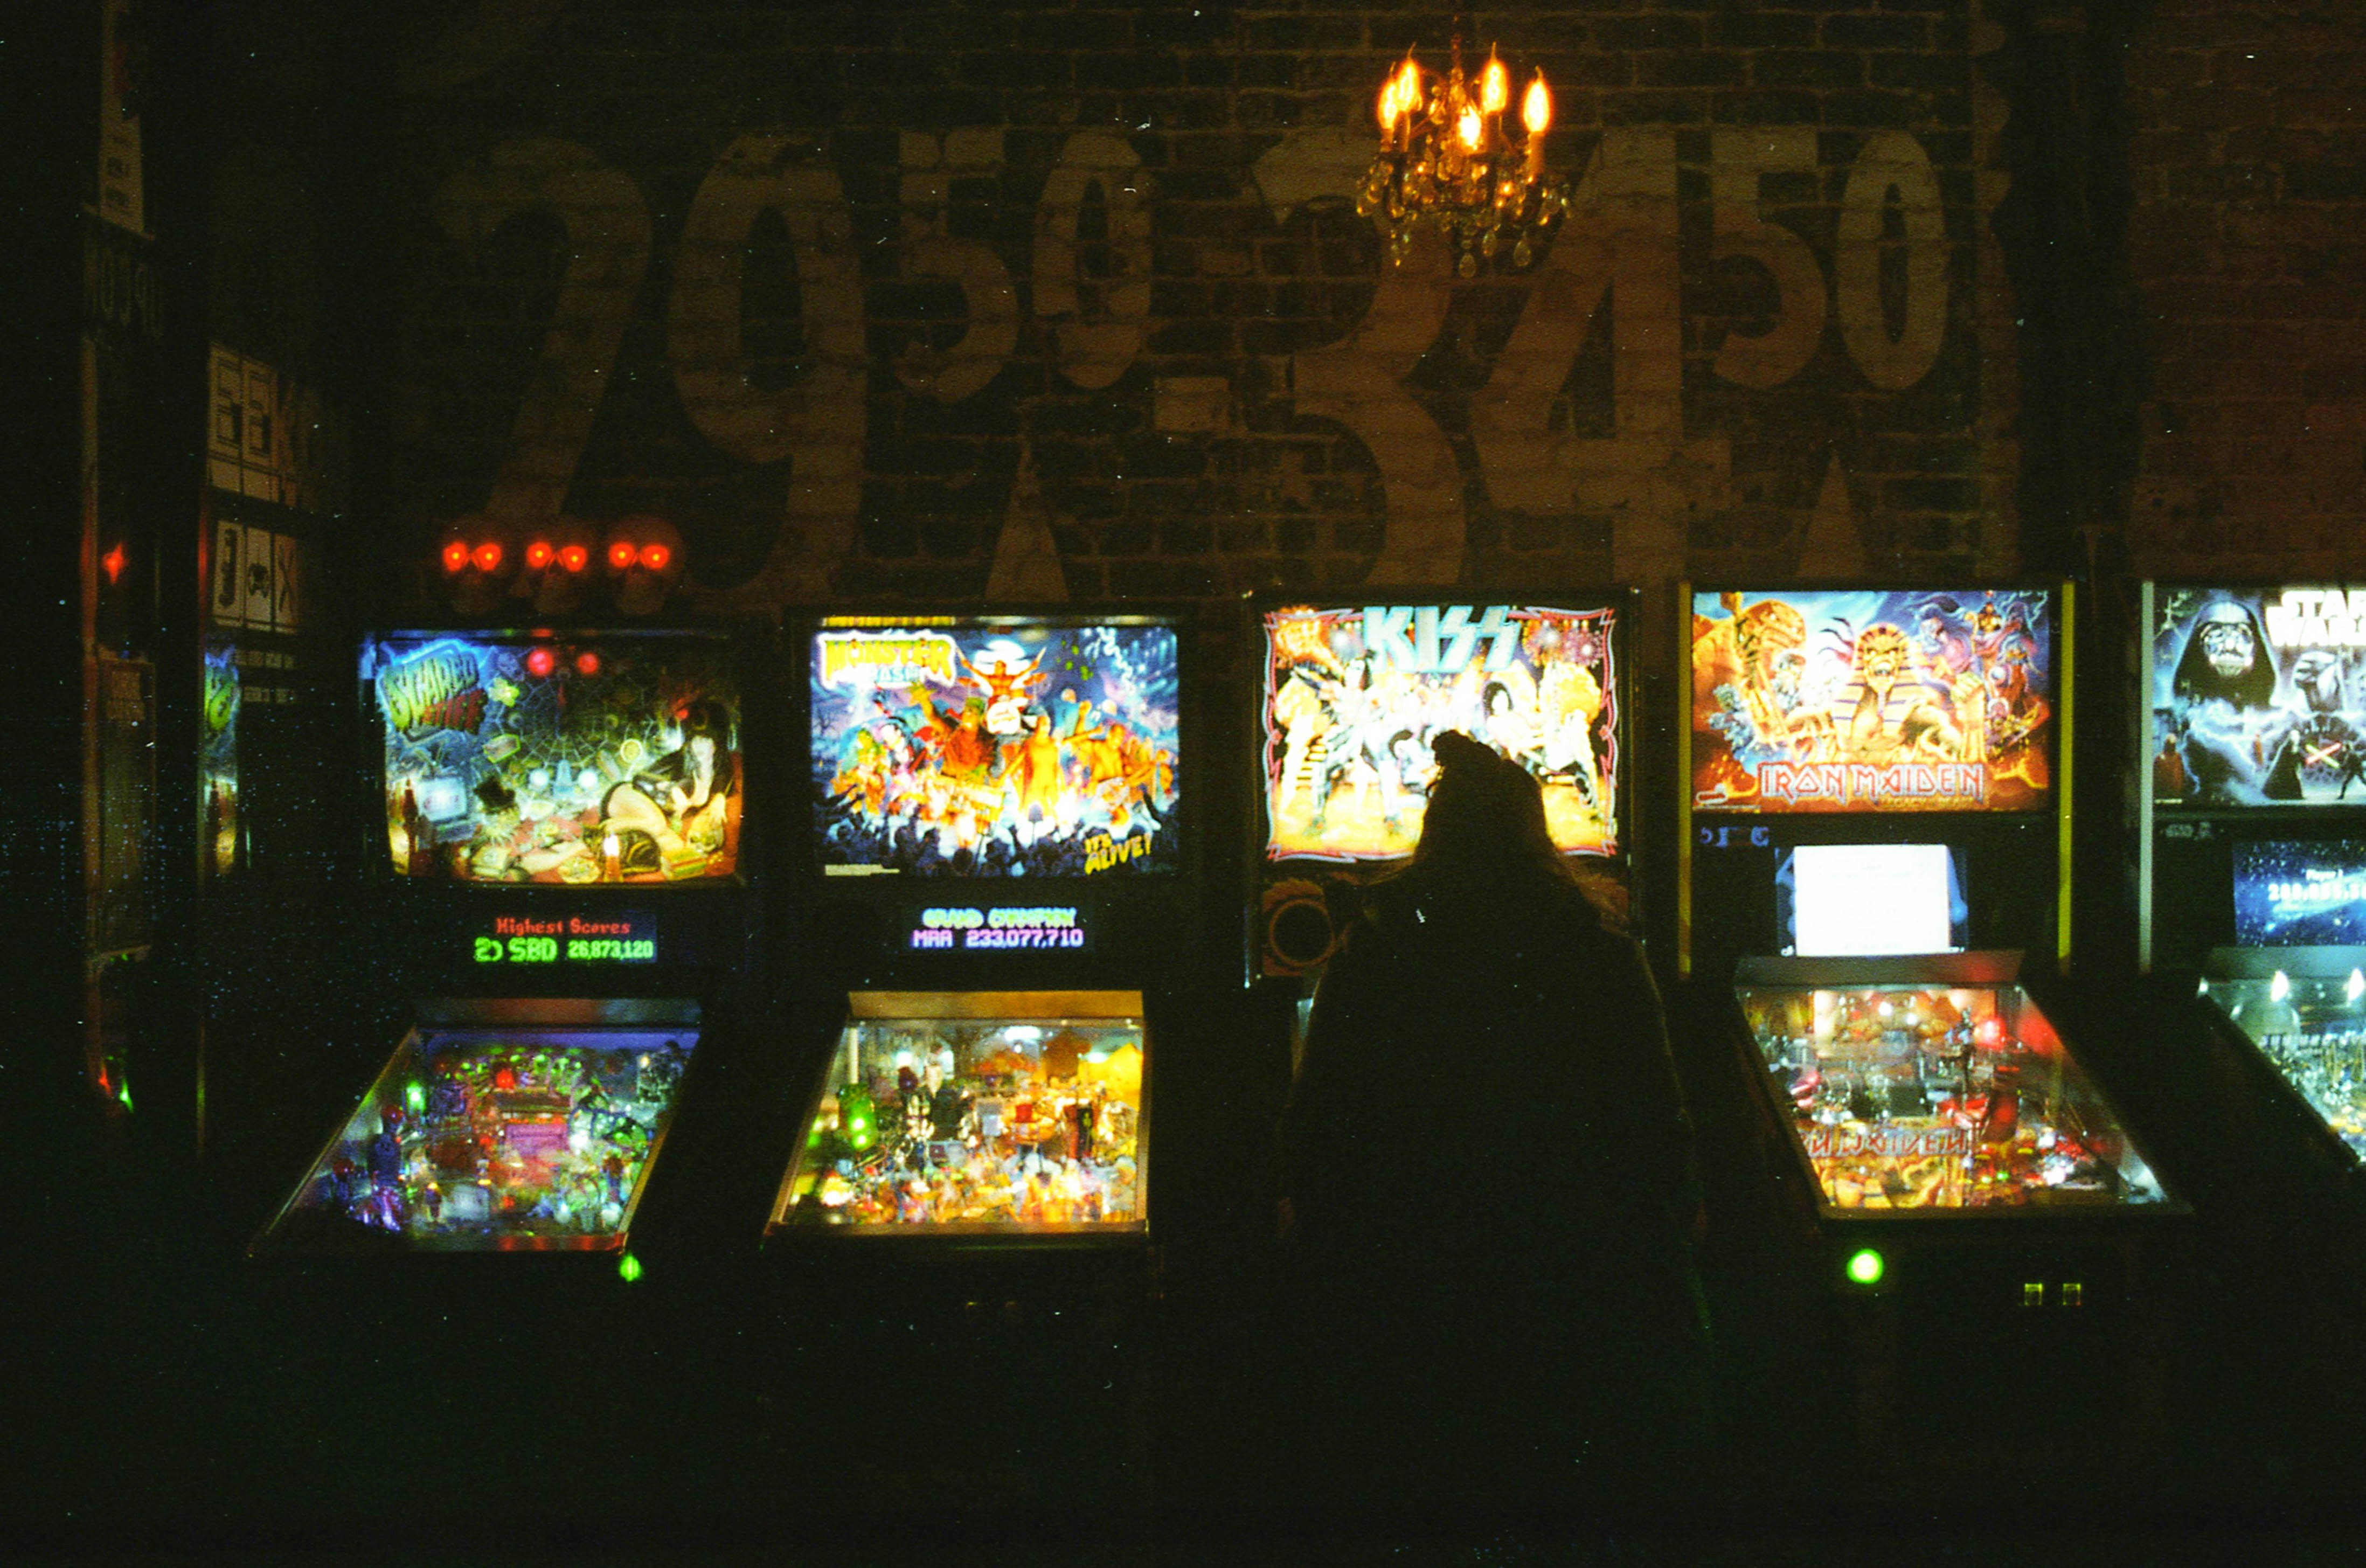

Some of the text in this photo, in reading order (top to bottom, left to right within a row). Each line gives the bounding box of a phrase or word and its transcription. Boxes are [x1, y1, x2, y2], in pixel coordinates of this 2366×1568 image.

[824, 638, 953, 681] MONSTER
[1363, 605, 1522, 674] KISS
[384, 654, 480, 731] SCARED
[1760, 763, 1984, 806] IRON MAIDEN
[1084, 833, 1151, 875] ALIVE!
[495, 917, 630, 936] Highest Scores
[966, 928, 1084, 949] 233,077,710
[567, 940, 654, 960] 26,873,120
